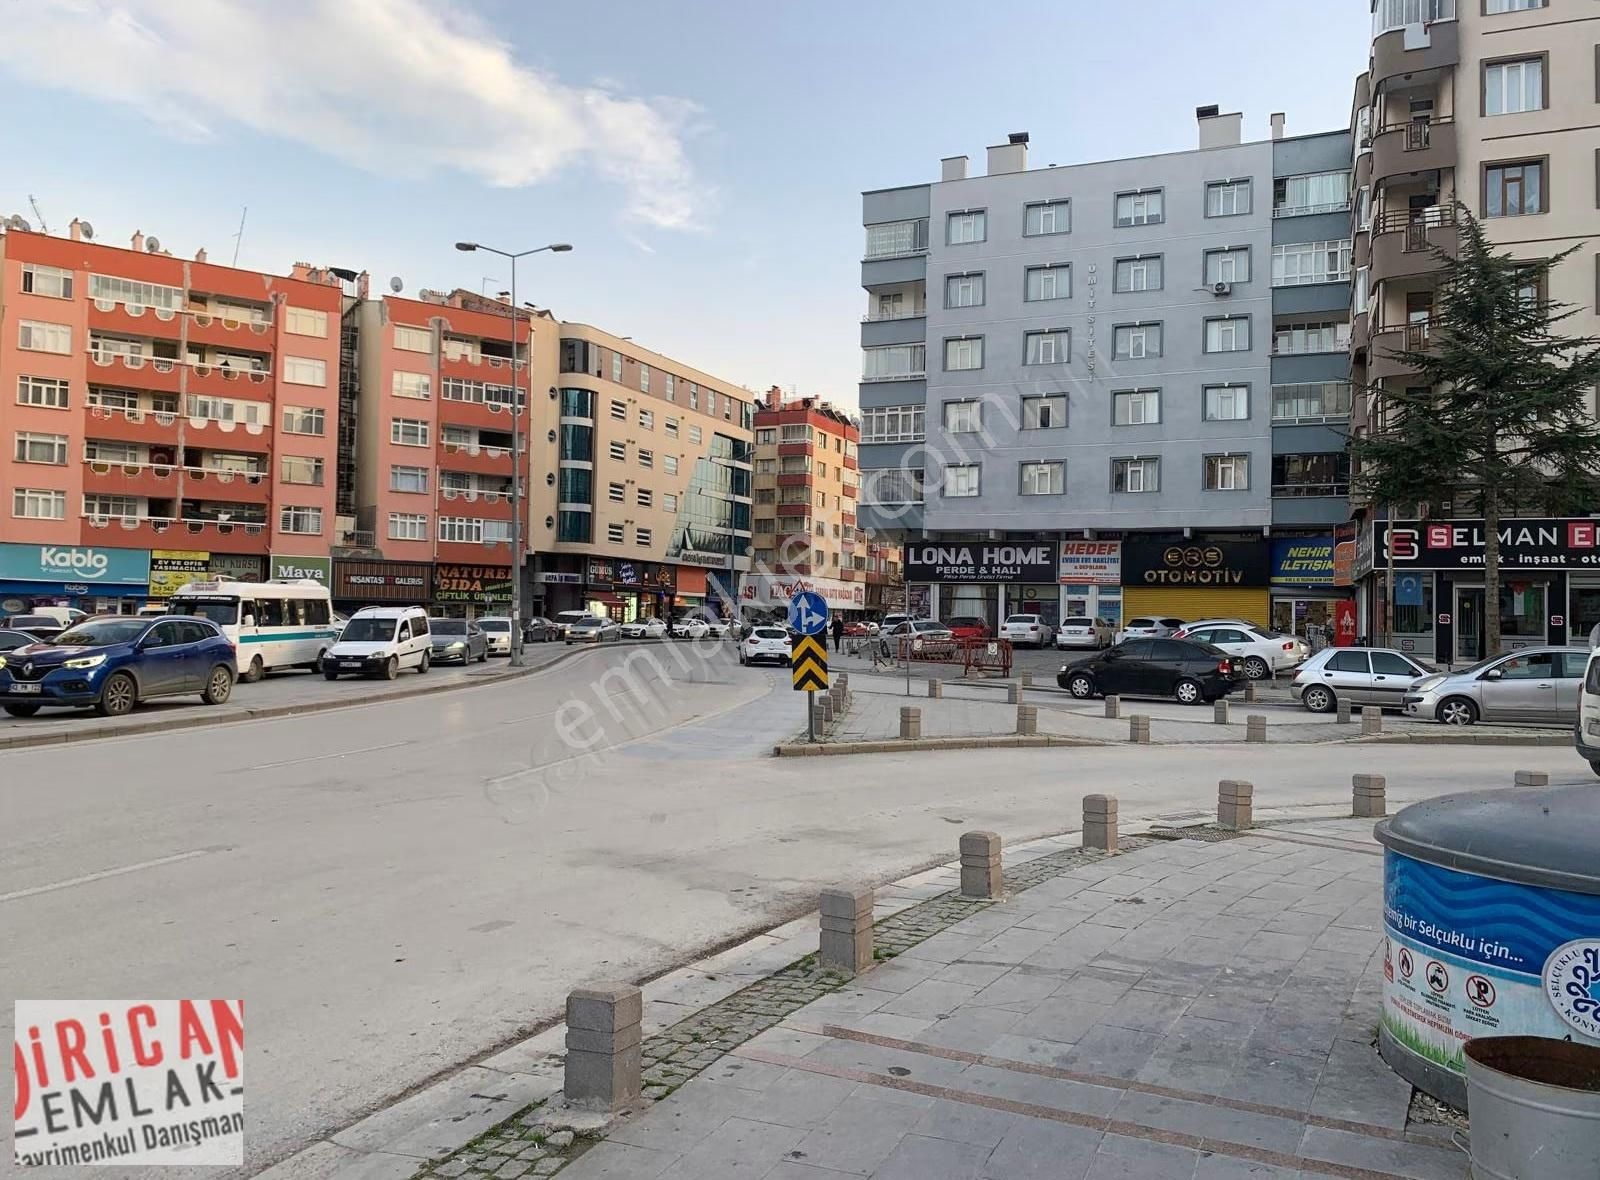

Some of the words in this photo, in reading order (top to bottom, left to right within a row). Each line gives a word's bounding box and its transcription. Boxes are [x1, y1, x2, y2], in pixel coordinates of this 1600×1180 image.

[1431, 527, 1557, 546] SELMAN
[1574, 527, 1600, 546] E
[909, 547, 974, 565] LONA
[983, 547, 1050, 565] HOME
[1064, 543, 1118, 555] HEDEF
[1166, 549, 1220, 564] ERS
[41, 547, 108, 568] Kablo
[1519, 554, 1566, 564] inşaat
[278, 565, 324, 580] Maya
[936, 566, 975, 574] PERDE
[979, 566, 988, 574] &
[992, 566, 1021, 574] HALI
[1144, 568, 1243, 583] OTOMOTİV
[440, 579, 483, 591] GIDA
[1404, 912, 1417, 930] bir
[1419, 920, 1475, 951] Selçuklu
[1552, 949, 1580, 998] SELÇUKLU
[1565, 1009, 1600, 1034] KONY
